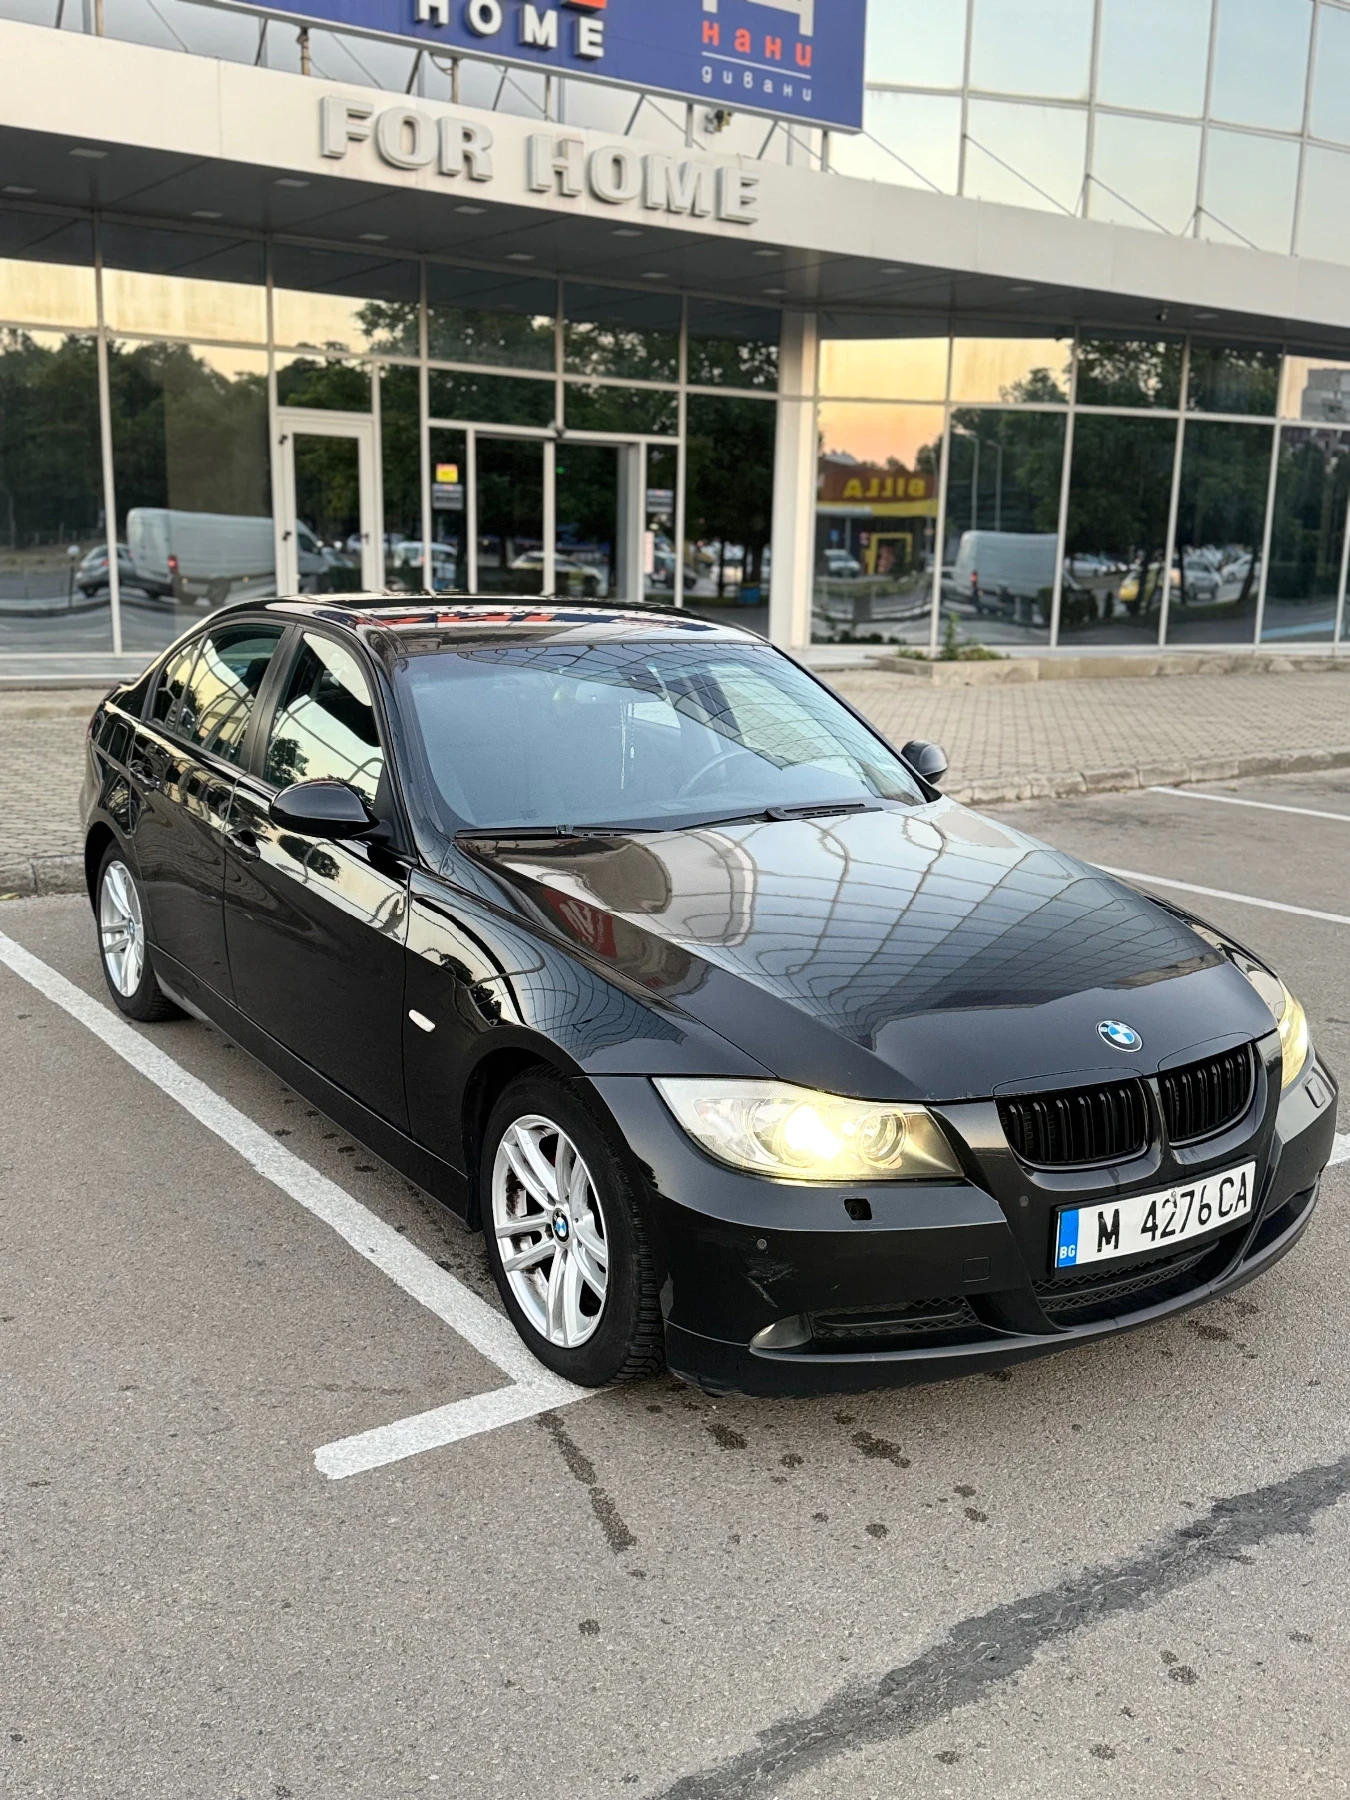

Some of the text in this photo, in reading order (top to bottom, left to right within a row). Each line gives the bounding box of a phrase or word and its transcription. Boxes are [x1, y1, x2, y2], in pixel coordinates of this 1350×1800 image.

[415, 0, 605, 59] HOME
[320, 95, 760, 224] FOR HOME
[1059, 1245, 1076, 1260] BG
[1097, 1208, 1120, 1253] M
